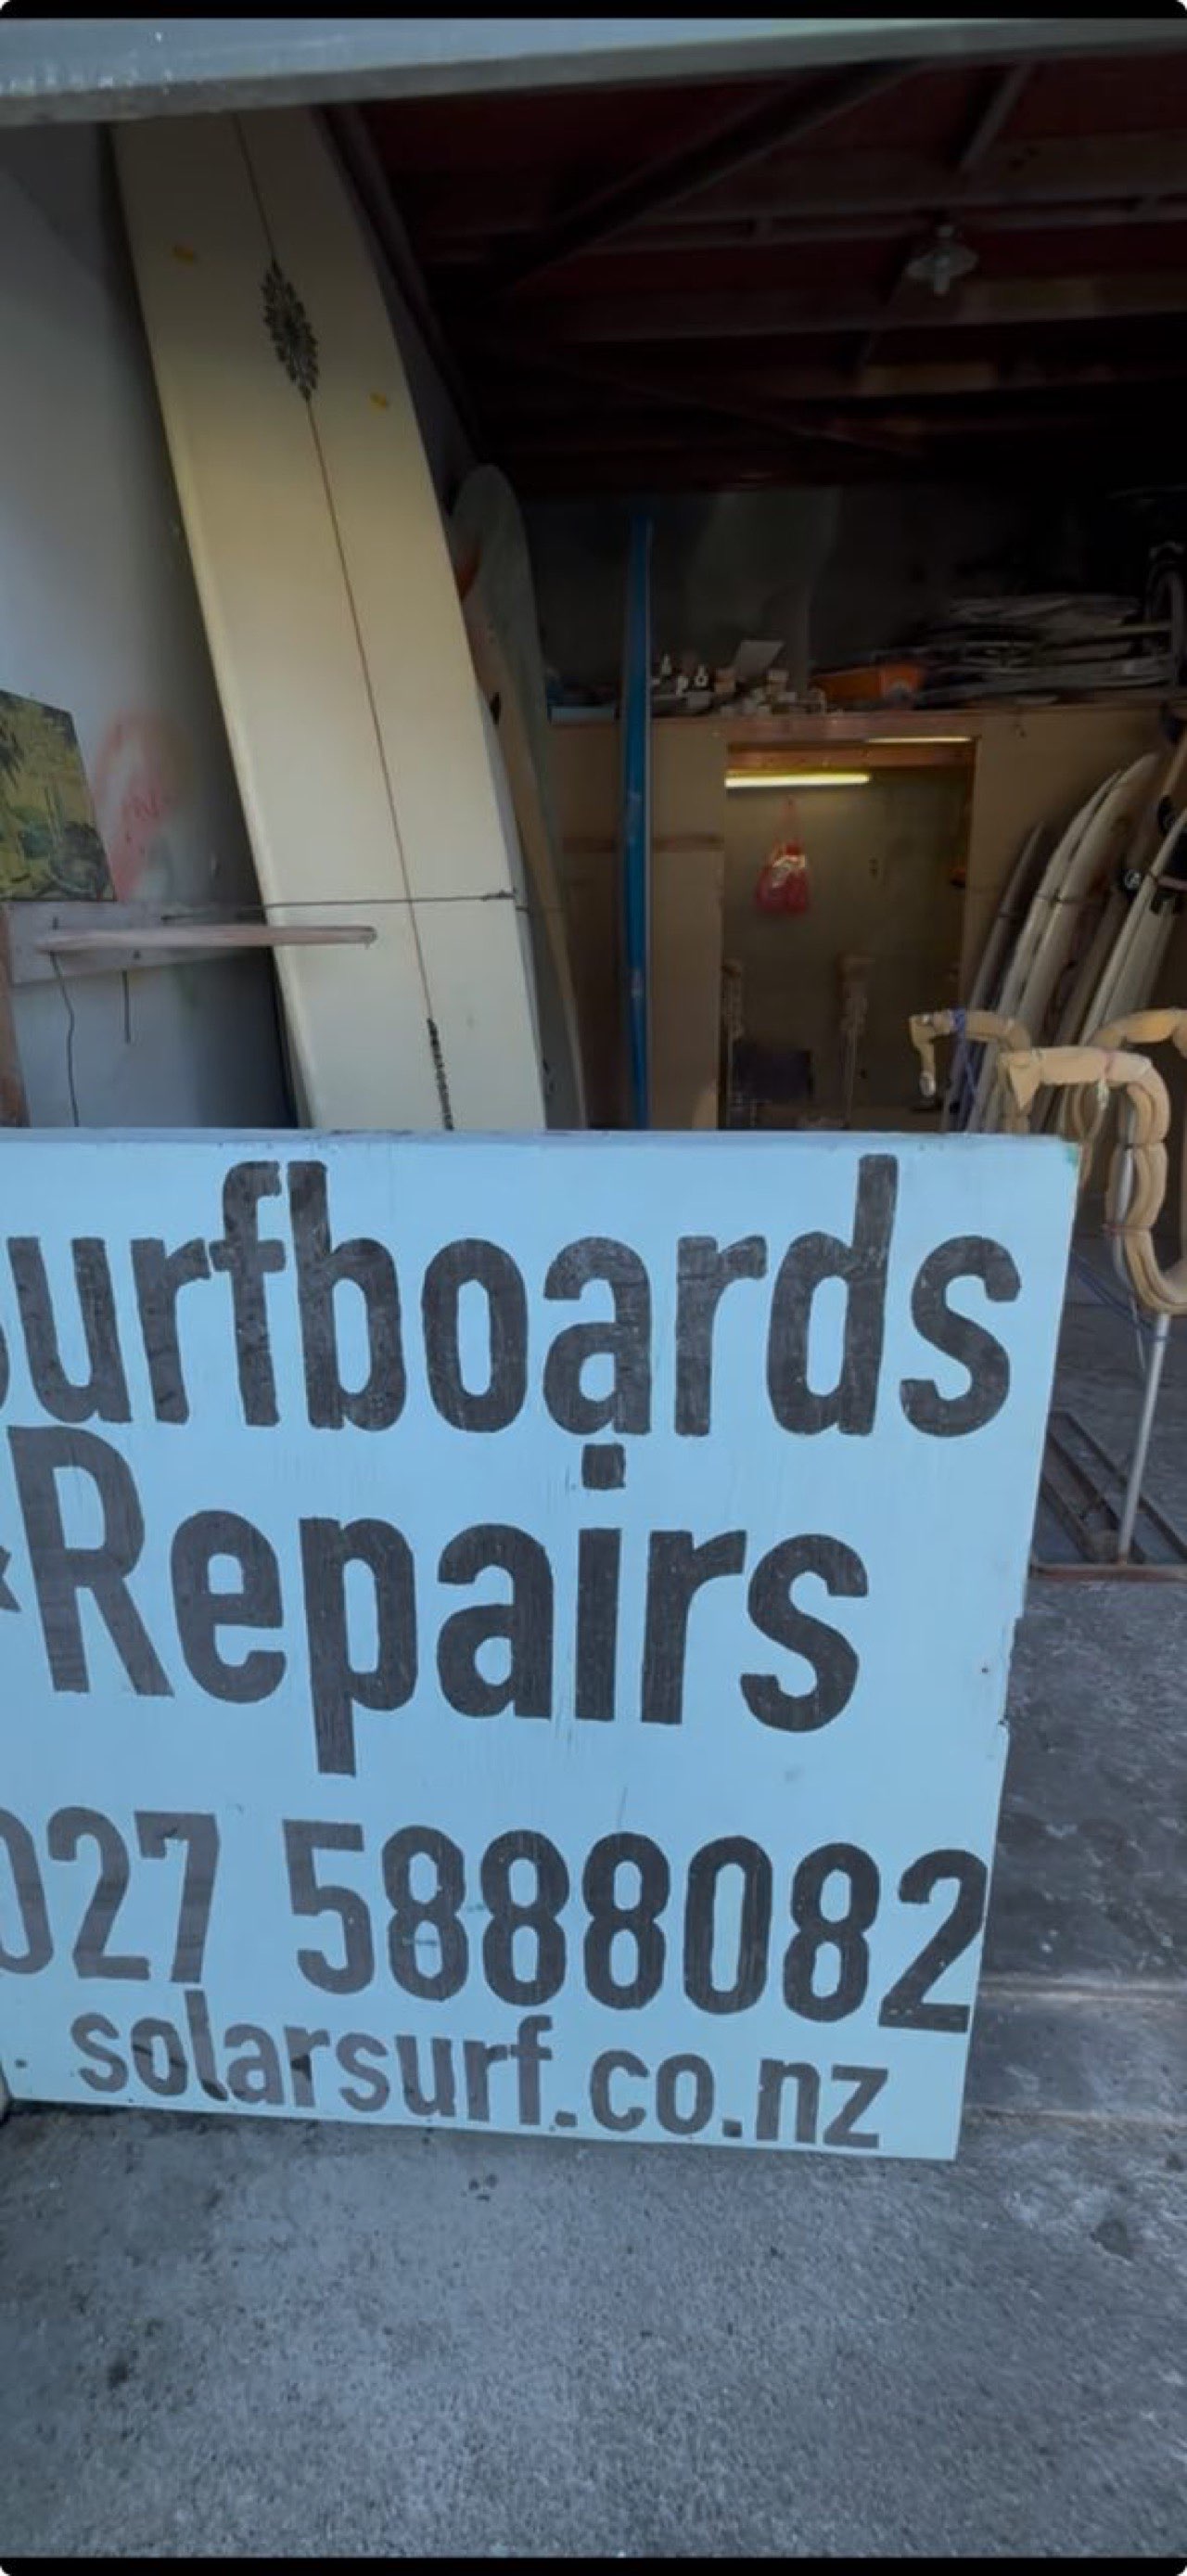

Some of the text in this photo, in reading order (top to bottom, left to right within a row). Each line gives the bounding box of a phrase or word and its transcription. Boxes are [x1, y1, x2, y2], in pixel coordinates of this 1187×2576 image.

[0, 1154, 1021, 1437] urfboards
[282, 1819, 989, 2033] 5888082
[70, 1990, 887, 2149] solarsurf.co.nz
